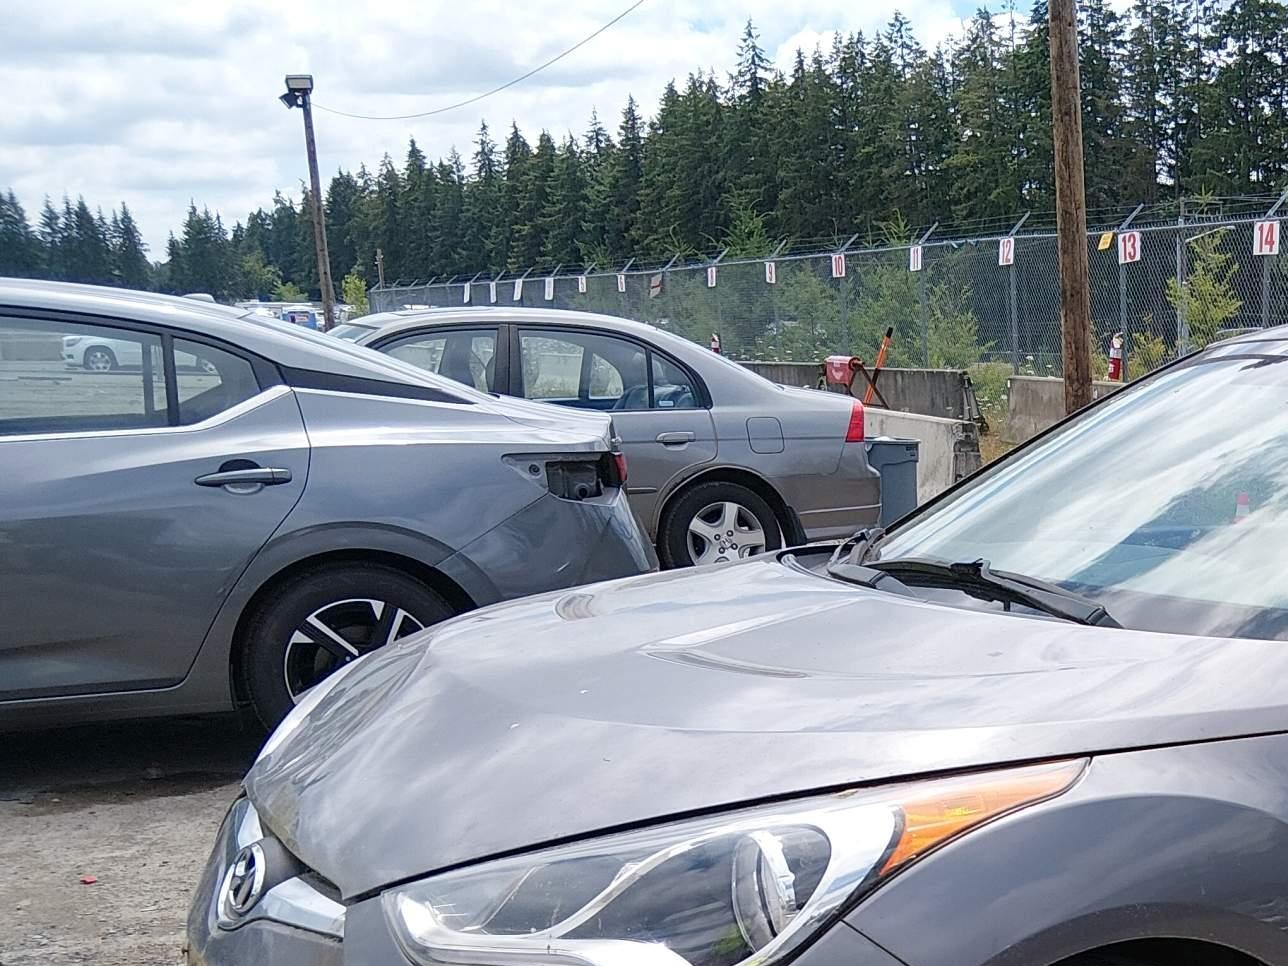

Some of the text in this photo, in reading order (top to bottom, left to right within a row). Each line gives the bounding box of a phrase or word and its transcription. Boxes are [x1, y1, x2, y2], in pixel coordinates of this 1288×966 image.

[1121, 233, 1137, 261] 13
[1258, 223, 1275, 253] 14
[911, 247, 919, 269] 11
[1002, 239, 1012, 263] 12
[768, 263, 773, 281] 9
[834, 255, 843, 275] 10
